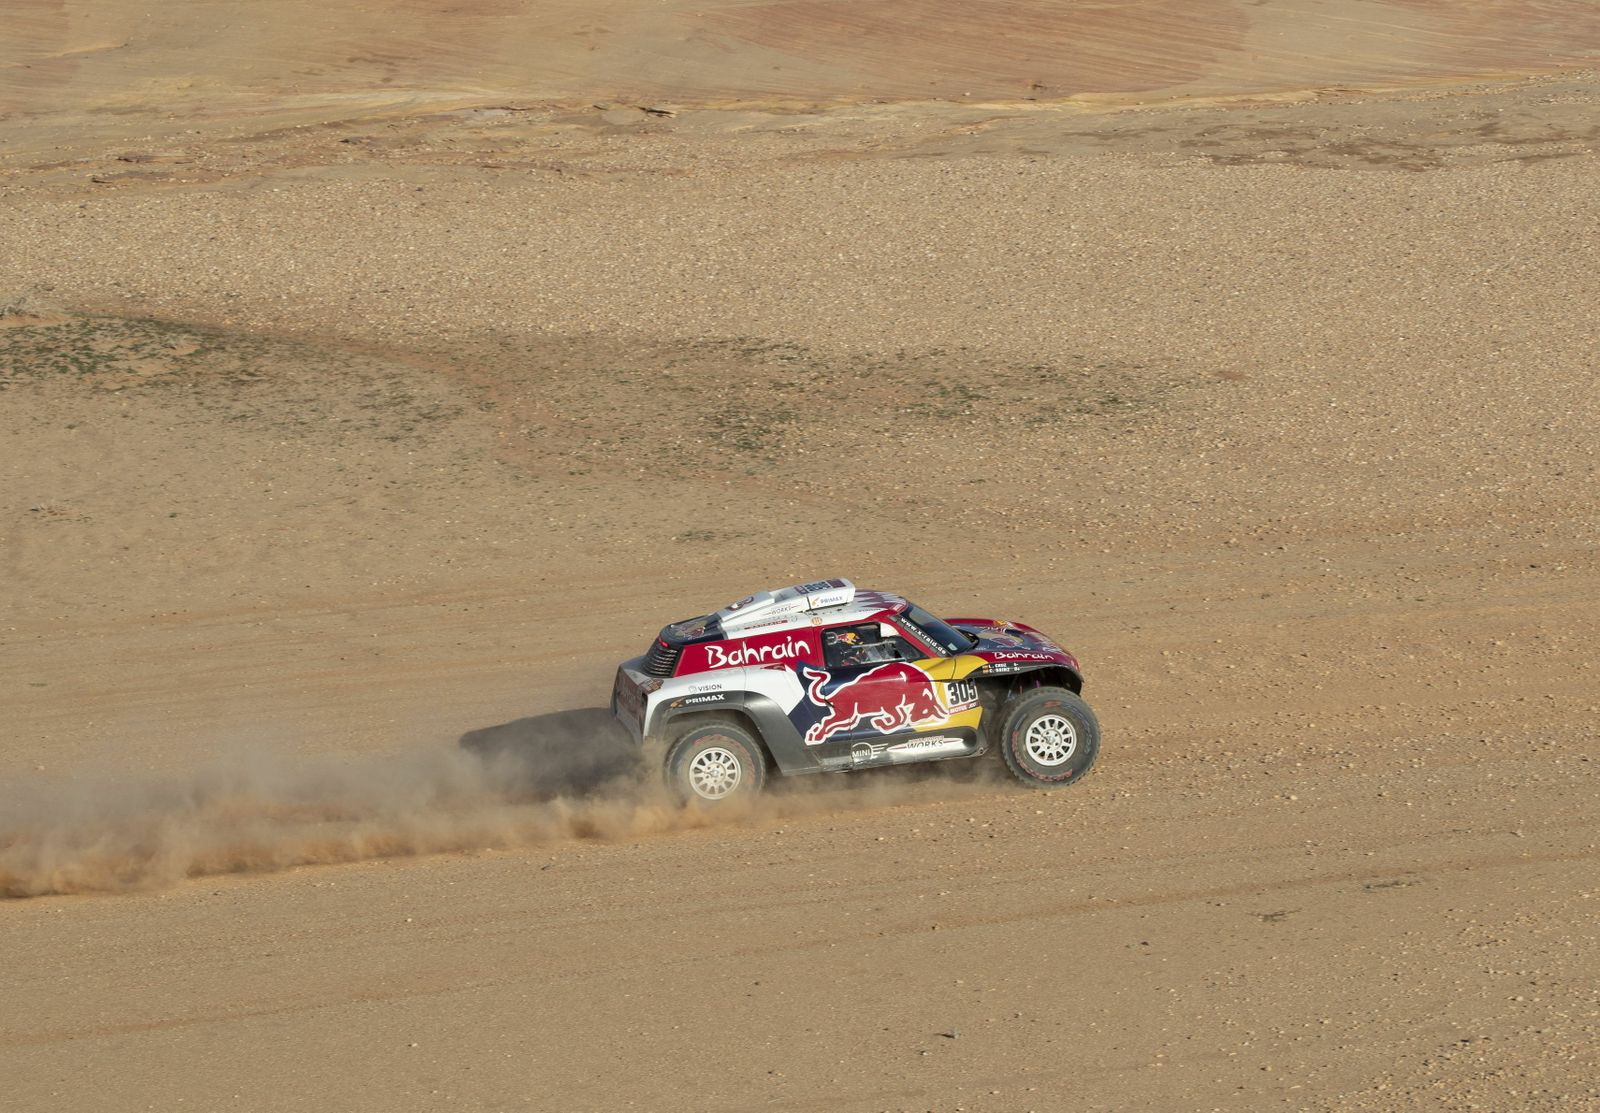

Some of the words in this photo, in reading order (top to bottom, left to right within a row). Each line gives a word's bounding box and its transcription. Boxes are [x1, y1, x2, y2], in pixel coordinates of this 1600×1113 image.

[900, 617, 947, 655] www.x-raid.de
[705, 636, 810, 668] Bahrain
[992, 651, 1054, 660] Bahrain
[697, 683, 722, 692] VISION
[947, 677, 978, 705] 305
[685, 693, 725, 705] PRIMAX
[906, 739, 944, 750] WORKS
[851, 749, 872, 759] MINI
